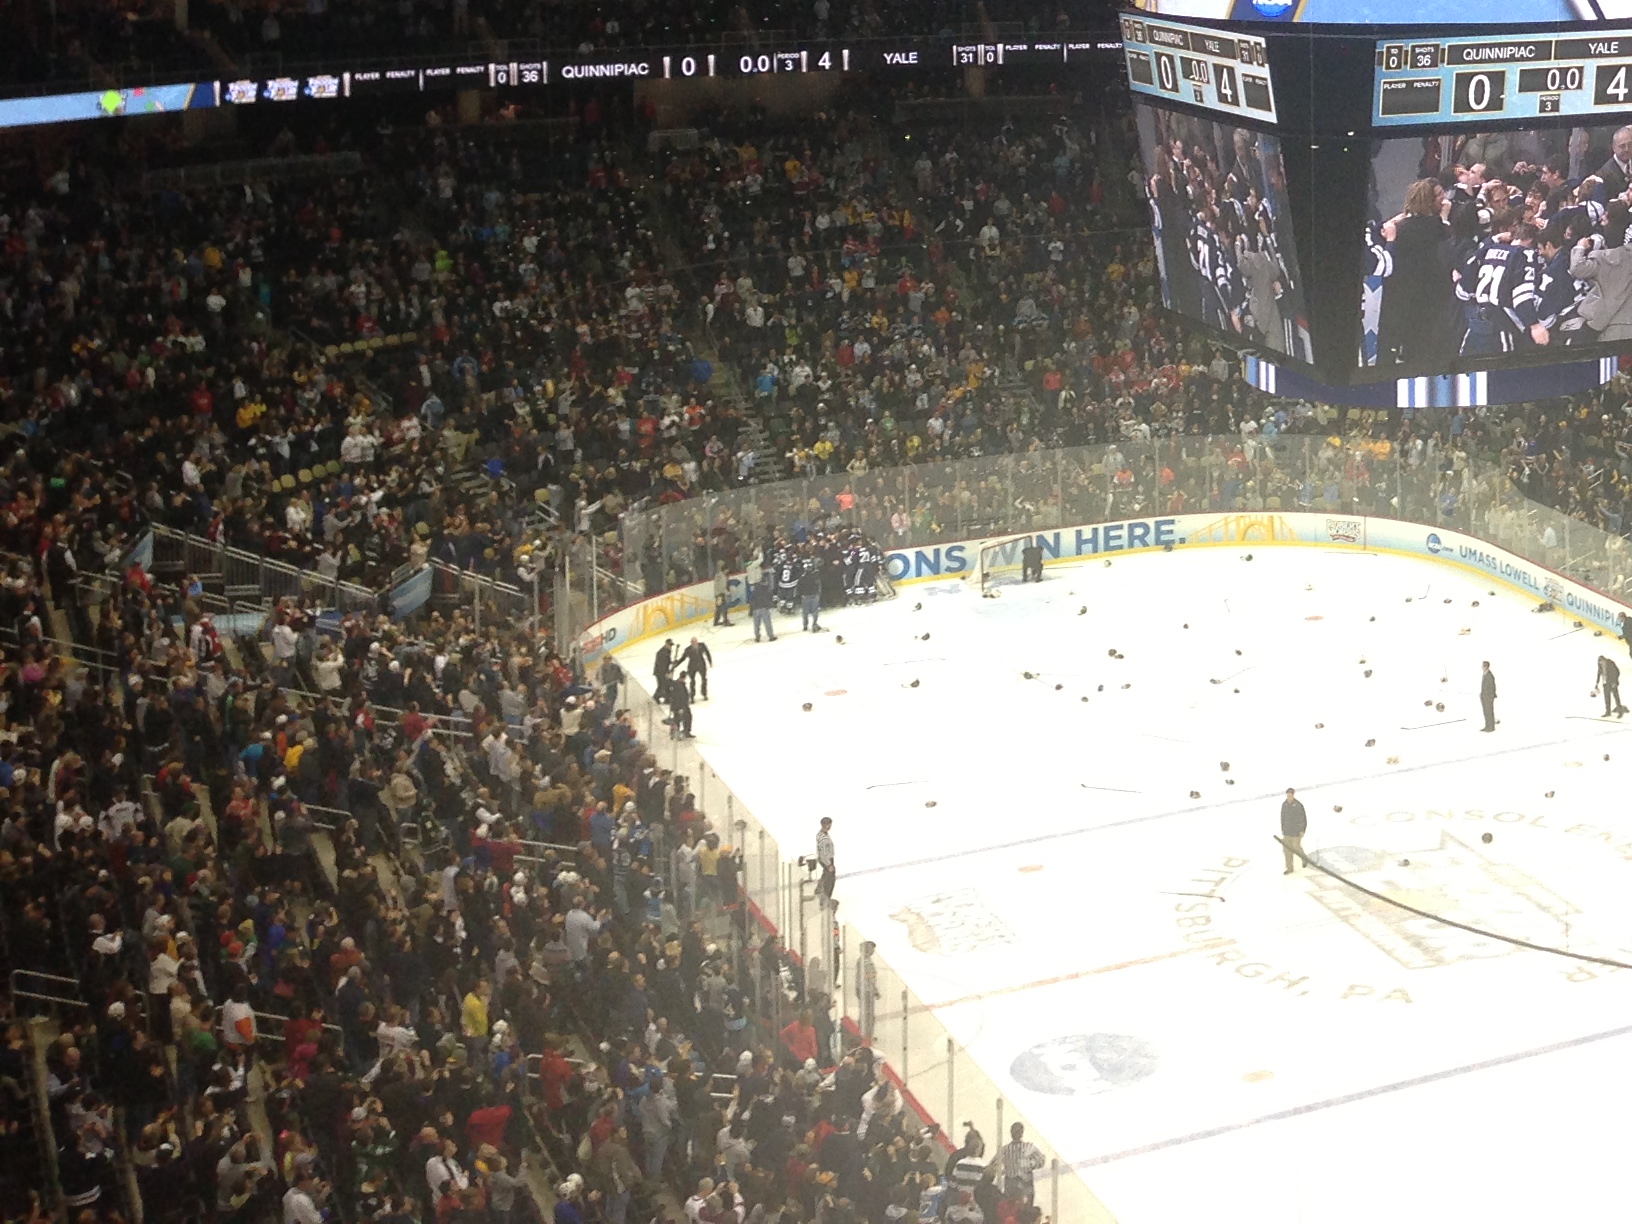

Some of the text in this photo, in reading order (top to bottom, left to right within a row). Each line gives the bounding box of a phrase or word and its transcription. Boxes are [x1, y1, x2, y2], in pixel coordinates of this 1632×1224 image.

[1152, 28, 1185, 46] QUINNIPIAC
[1204, 38, 1221, 53] YALE
[1462, 45, 1536, 62] QUINNIPIAC
[1588, 41, 1620, 55] YALE
[681, 57, 696, 76] 0
[739, 55, 770, 73] 0.0
[784, 60, 793, 71] 3
[818, 51, 832, 70] 4
[883, 52, 918, 65] YALE
[960, 52, 973, 64] 31
[986, 52, 995, 64] 0
[1389, 56, 1398, 68] 0
[1416, 54, 1431, 67] 36
[497, 71, 507, 84] 0
[521, 70, 539, 83] 36
[561, 63, 650, 78] QUINNIPIAC
[1160, 55, 1173, 90] 0
[1546, 68, 1580, 91] 0.0
[1220, 67, 1233, 103] 4
[1468, 74, 1491, 111] 0
[1606, 66, 1629, 102] 4
[1544, 101, 1552, 111] 3
[1475, 263, 1506, 306] 21
[1074, 519, 1187, 556] HERE.
[1459, 544, 1498, 571] UMASS
[1499, 560, 1541, 591] LOWELL
[1566, 592, 1623, 628] QUINNIPIA
[1350, 808, 1550, 831] CONSOL
[1340, 981, 1415, 1005] PA
